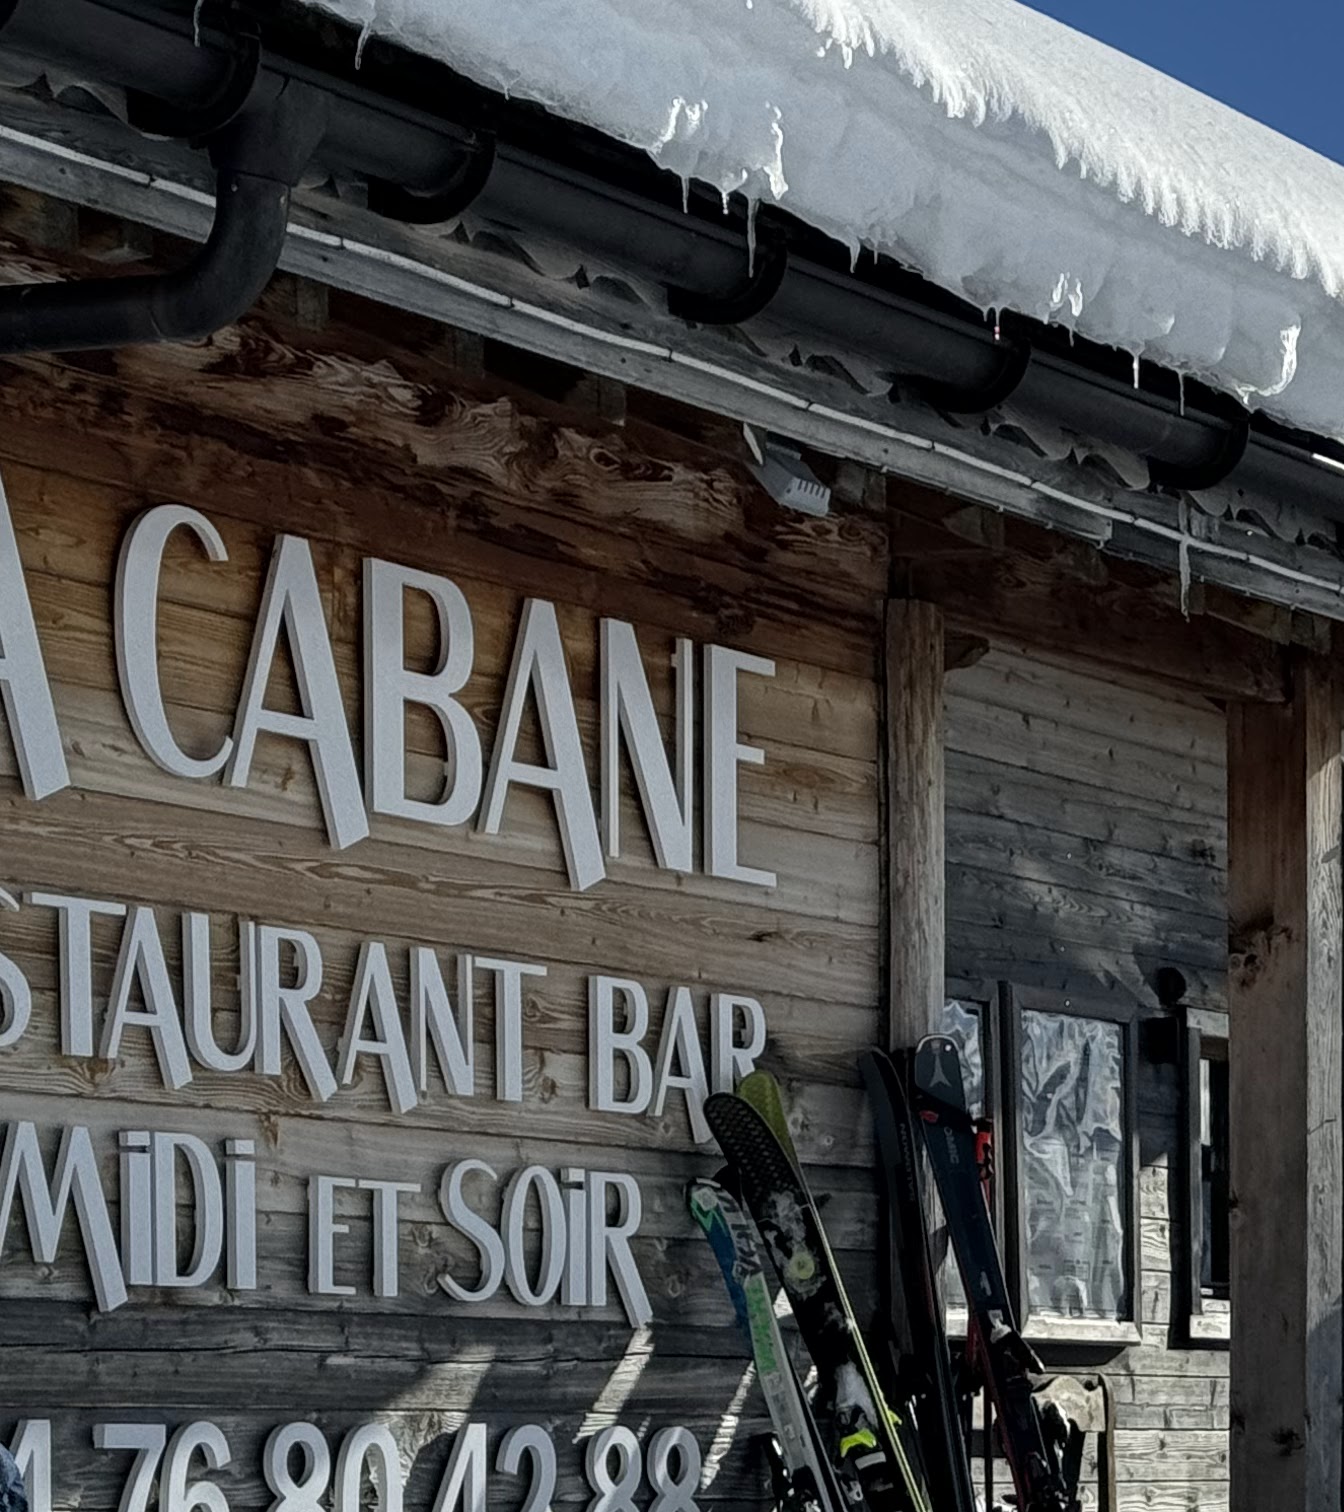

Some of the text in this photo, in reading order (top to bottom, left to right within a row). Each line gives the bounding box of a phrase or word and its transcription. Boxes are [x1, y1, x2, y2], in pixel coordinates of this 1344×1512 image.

[115, 504, 776, 891] CABANE
[588, 974, 767, 1144] BAR
[309, 1175, 421, 1298] ET
